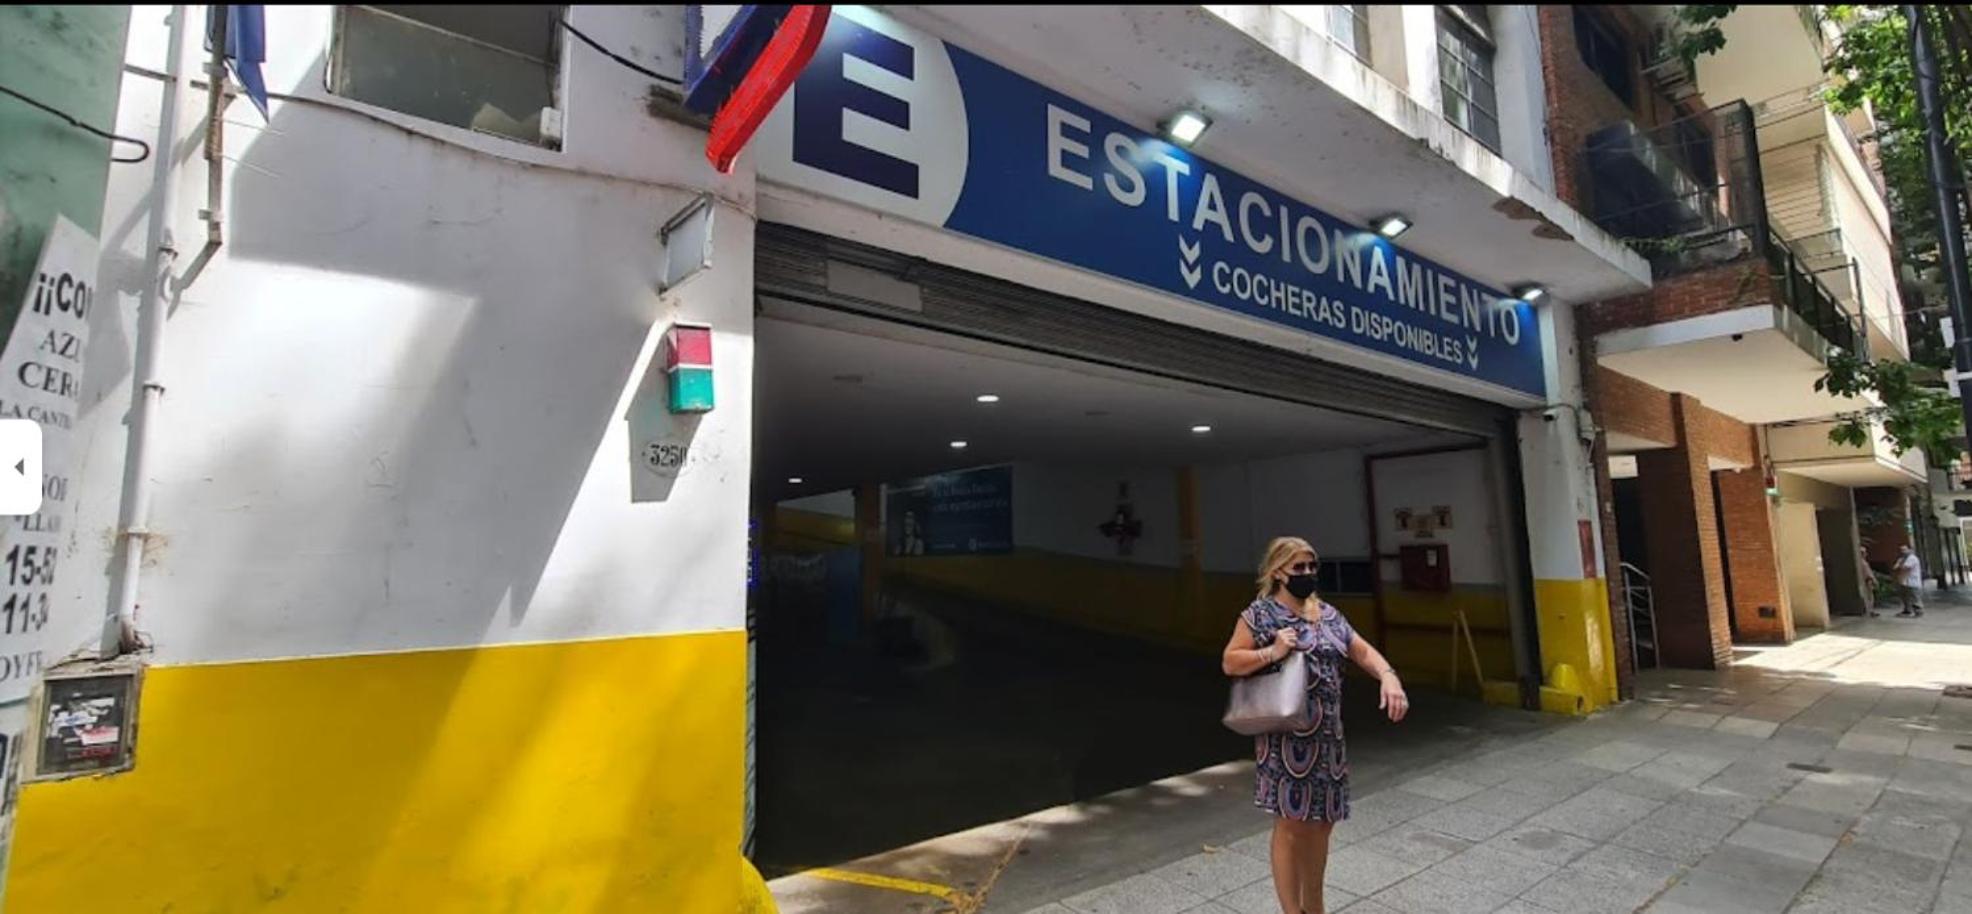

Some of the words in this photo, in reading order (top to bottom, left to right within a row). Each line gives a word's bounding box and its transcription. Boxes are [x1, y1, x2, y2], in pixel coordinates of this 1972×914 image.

[793, 15, 920, 200] E
[1046, 103, 1520, 345] ESTACIONAMIENTO
[32, 271, 93, 321] ¡¡CO
[1212, 260, 1346, 329] COCHERAS
[1351, 306, 1463, 364] DISPONIBLES
[17, 361, 79, 398] CER
